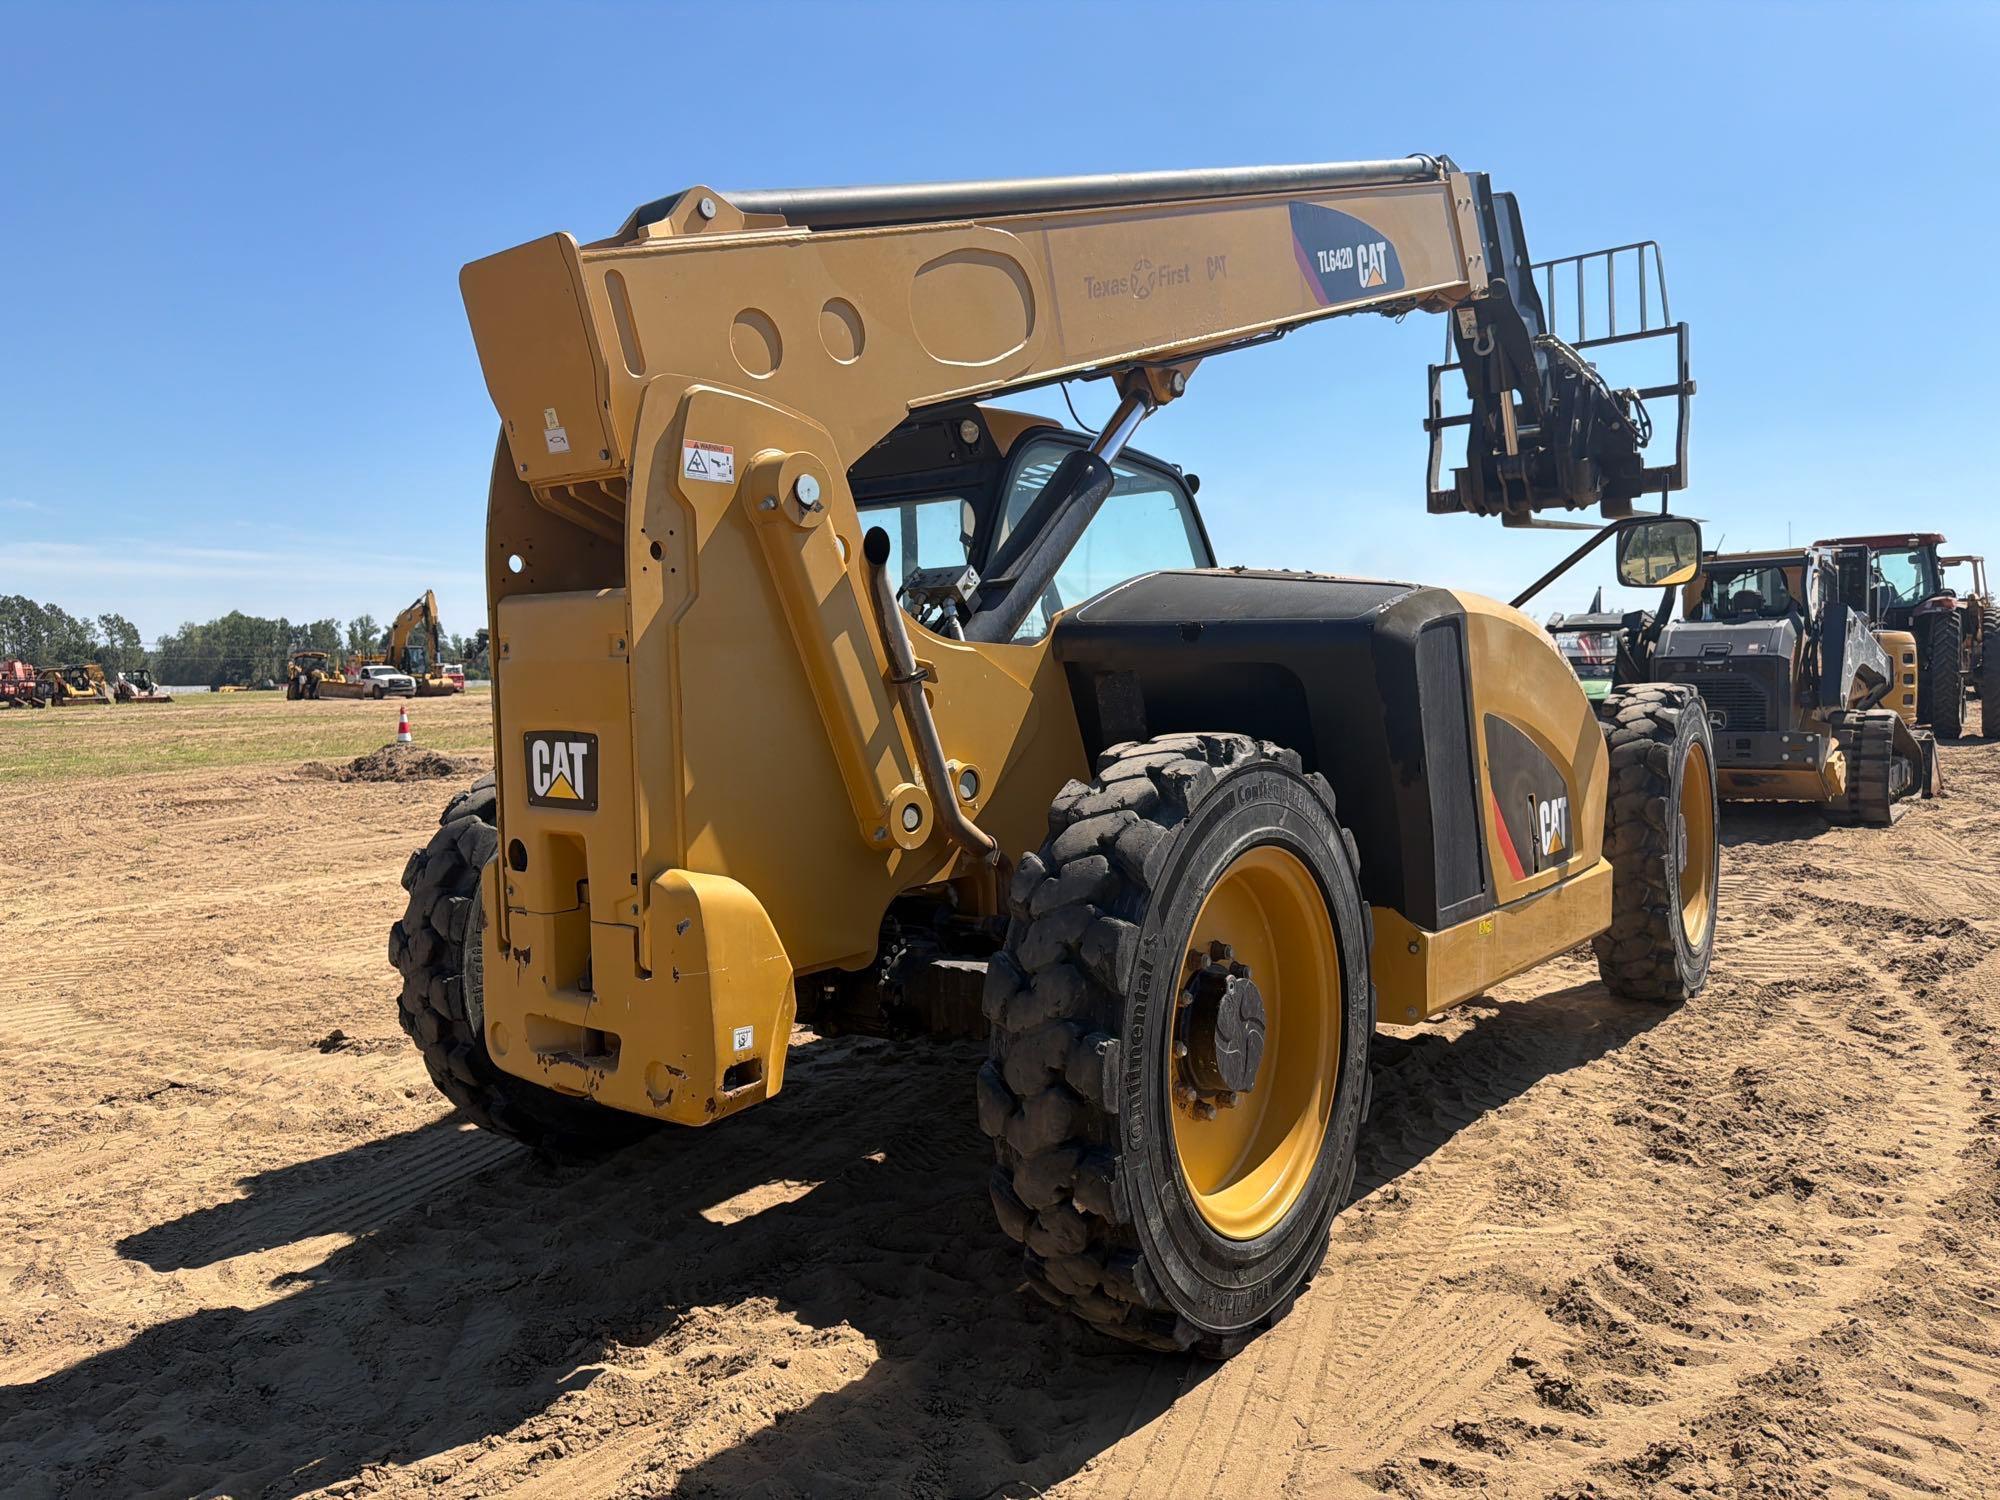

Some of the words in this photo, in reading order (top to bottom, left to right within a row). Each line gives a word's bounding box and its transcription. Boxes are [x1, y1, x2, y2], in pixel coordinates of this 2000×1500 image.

[1084, 275, 1129, 299] Texas
[1159, 263, 1190, 287] First
[1207, 255, 1228, 281] CAT
[1318, 247, 1354, 273] TL642D
[1357, 242, 1387, 288] CAT
[532, 740, 588, 800] CAT
[1539, 796, 1567, 857] CAT
